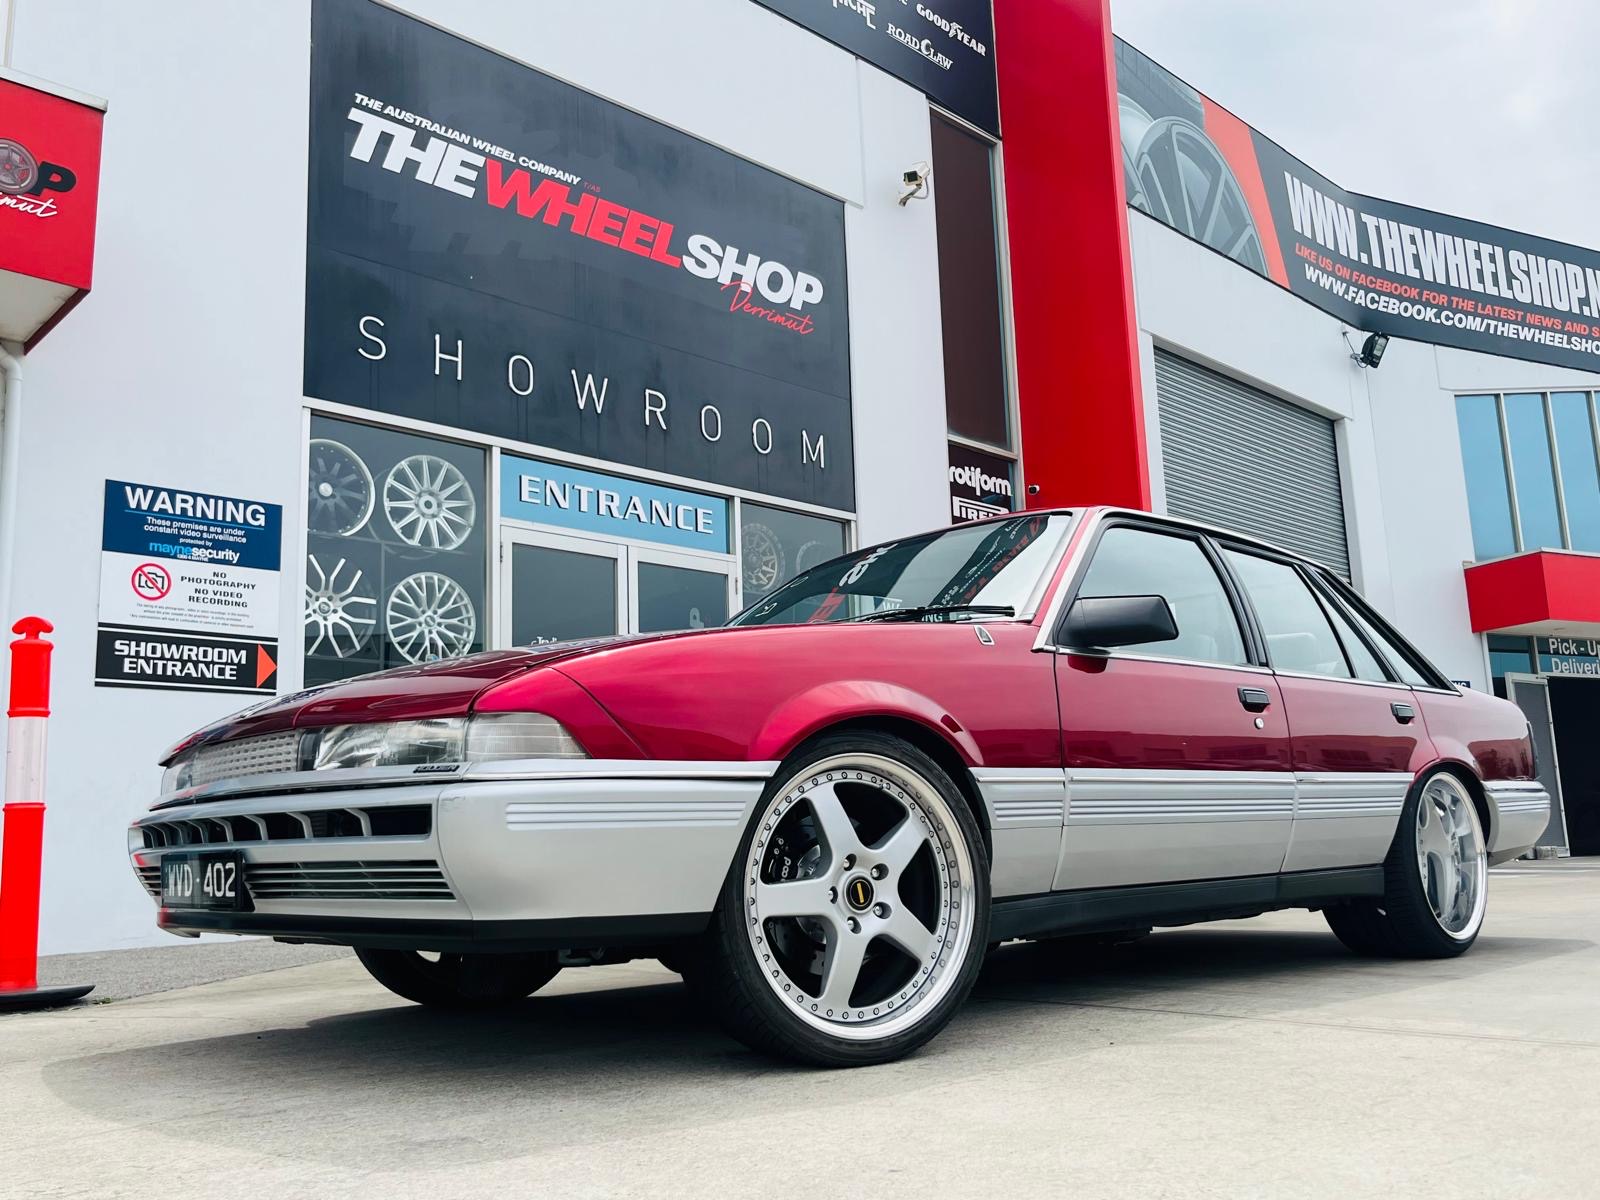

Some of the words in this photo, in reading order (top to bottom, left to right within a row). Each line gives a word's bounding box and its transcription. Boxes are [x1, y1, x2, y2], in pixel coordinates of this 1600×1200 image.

[916, 3, 986, 56] GOODYEAR
[354, 92, 382, 112] THE
[383, 105, 470, 145] AUSTRALIAN
[473, 137, 516, 163] WHEEL
[518, 155, 581, 185] COMPANY
[1295, 242, 1317, 263] LIKE
[1318, 254, 1333, 272] US
[1334, 262, 1350, 280] ON
[1352, 271, 1420, 300] FACEBOOK
[1422, 290, 1448, 307] FOR
[1451, 296, 1475, 312] THE
[1477, 302, 1524, 322] LATEST
[1526, 313, 1562, 331] NEWS
[1564, 321, 1589, 336] AND
[720, 280, 814, 335] Derrimut
[357, 315, 826, 469] SHOWROOM
[949, 465, 1012, 497] rotiform
[125, 485, 266, 527] WARNING
[519, 474, 714, 534] ENTRANCE
[144, 525, 178, 535] constant
[180, 529, 201, 538] video
[202, 532, 247, 544] surveillance
[146, 516, 171, 527] These
[172, 520, 208, 532] premises
[209, 525, 222, 533] are
[223, 527, 246, 537] under
[180, 575, 257, 590] PHOTOGRAPHY
[212, 590, 243, 599] VIDEO
[188, 595, 248, 608] RECORDING
[114, 639, 247, 665] SHOWROOM
[1548, 637, 1578, 655] Pick
[123, 657, 238, 680] ENTRANCE
[203, 862, 236, 897] 402
